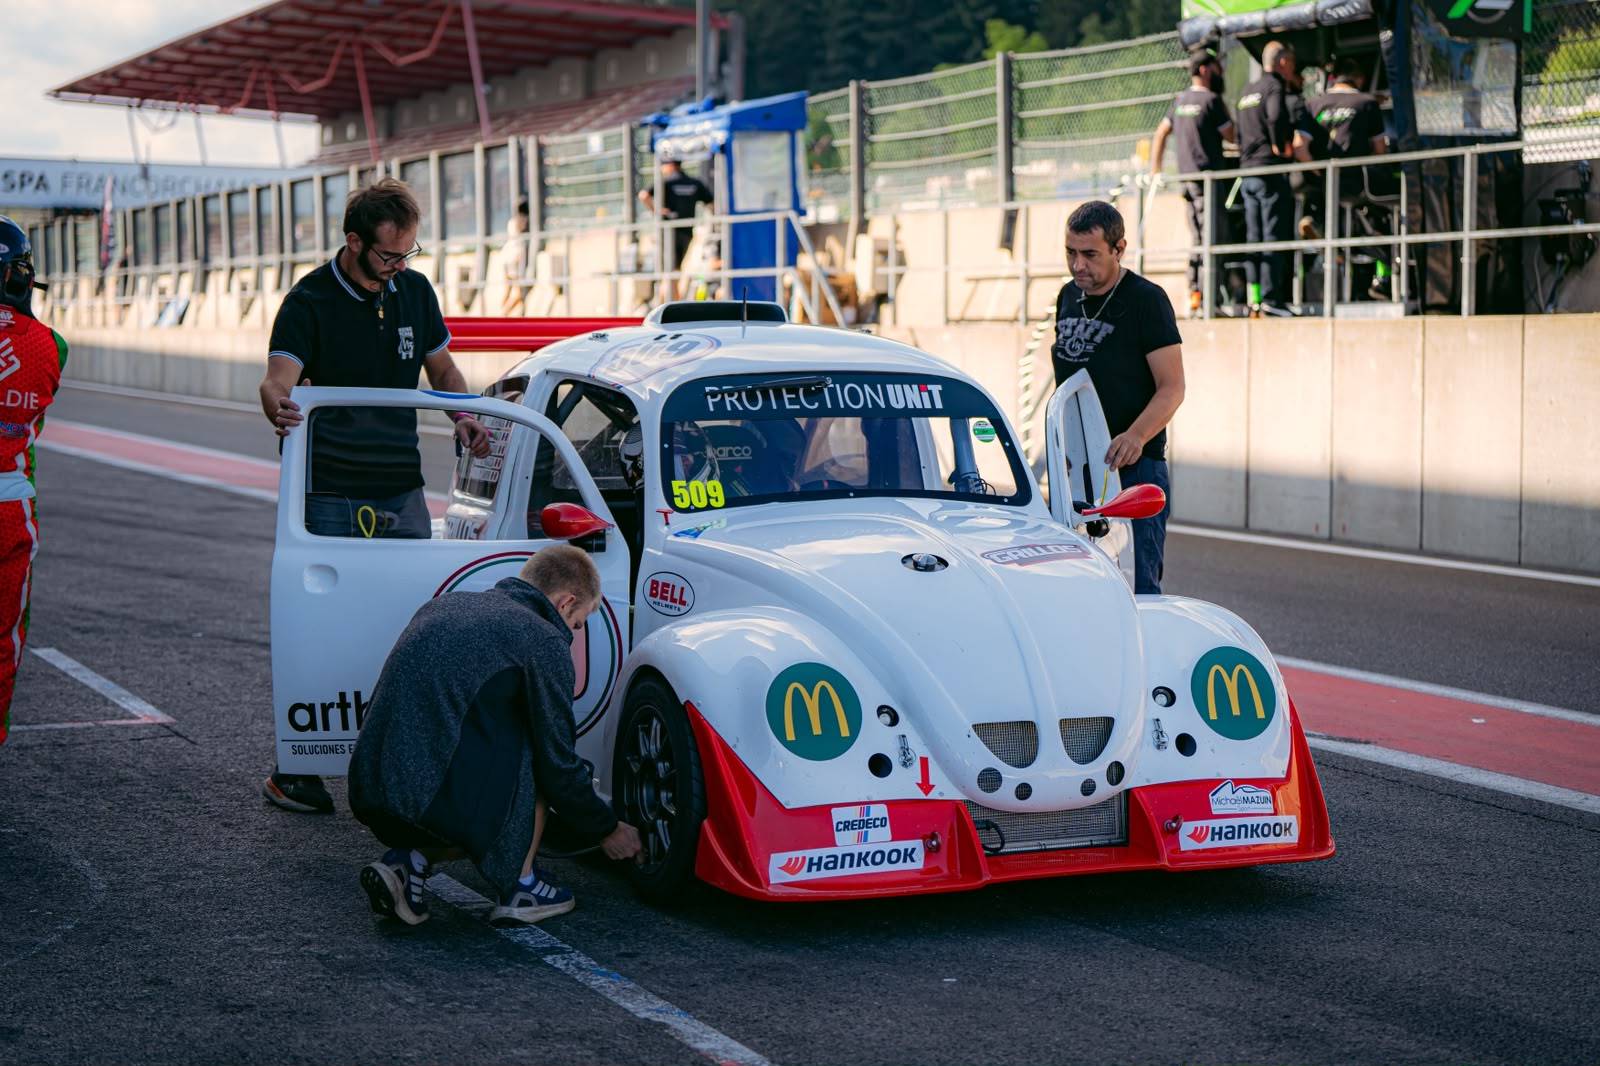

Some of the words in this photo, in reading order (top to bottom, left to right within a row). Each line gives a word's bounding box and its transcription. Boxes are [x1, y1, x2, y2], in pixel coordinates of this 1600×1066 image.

[2, 169, 49, 193] SPA
[0, 389, 39, 410] DIE
[704, 385, 885, 412] PROTECTION
[671, 480, 725, 508] 509
[649, 578, 687, 606] BELL
[291, 744, 346, 755] SOLUCIONES
[1242, 795, 1271, 804] MAZUIN
[835, 817, 887, 832] CREDECO
